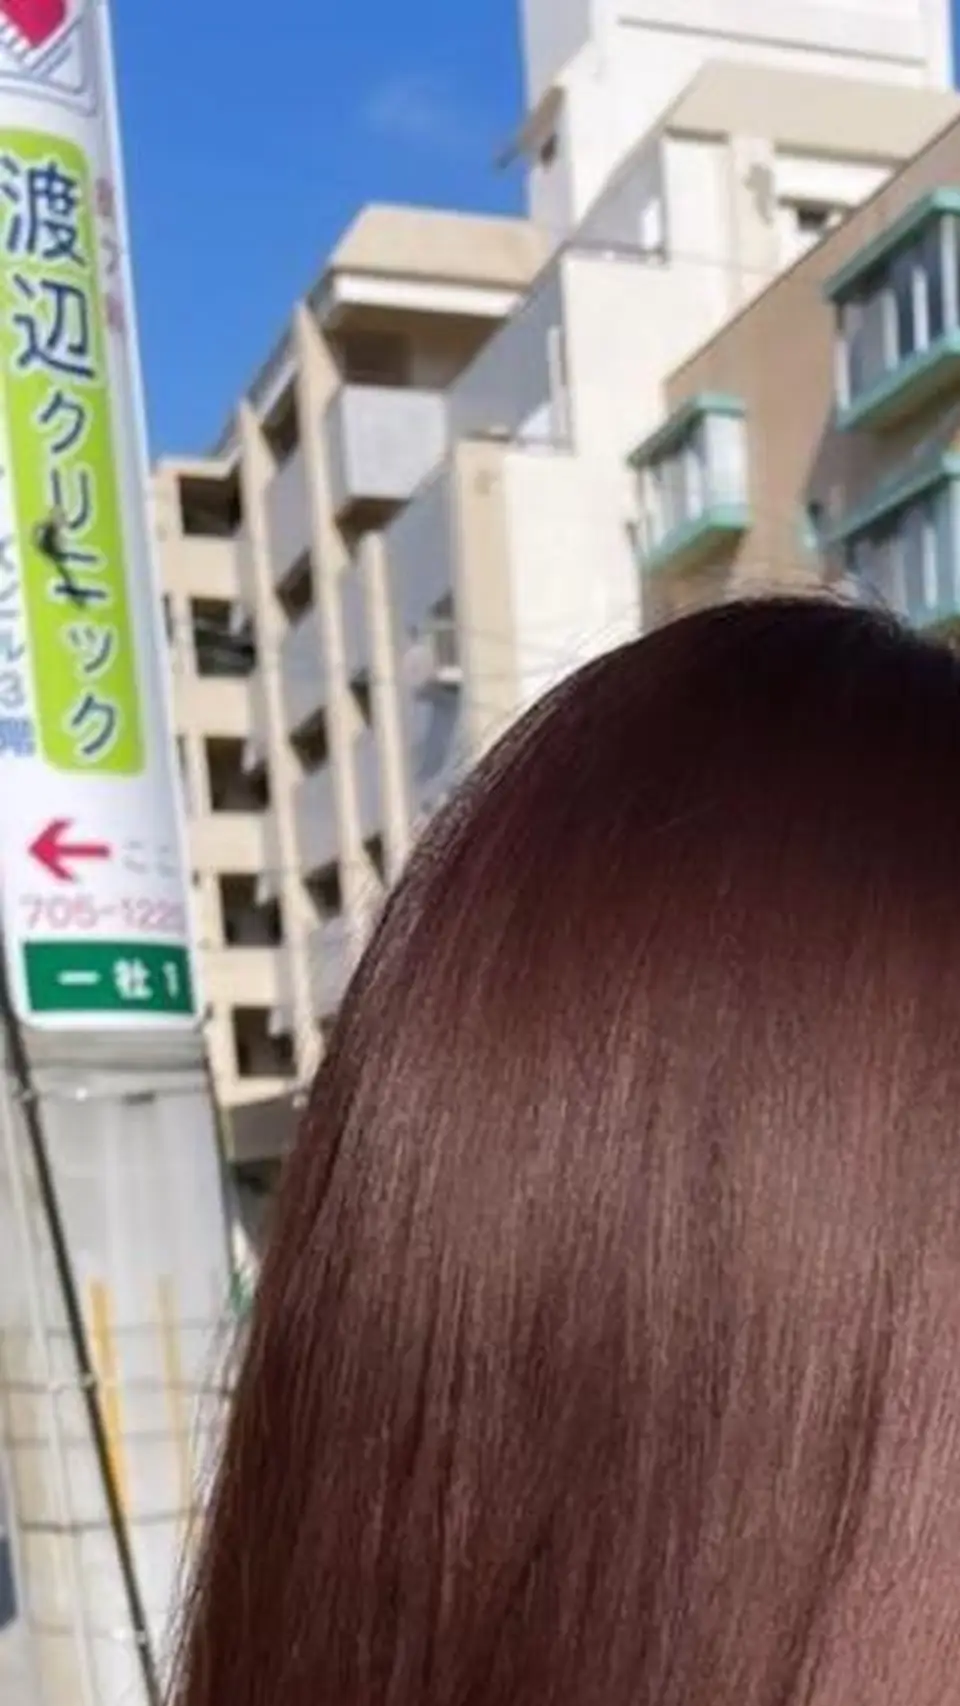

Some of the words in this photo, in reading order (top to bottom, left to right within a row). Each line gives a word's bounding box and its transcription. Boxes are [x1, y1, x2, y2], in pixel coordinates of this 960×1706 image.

[1, 154, 118, 756] 渡辺クリニック
